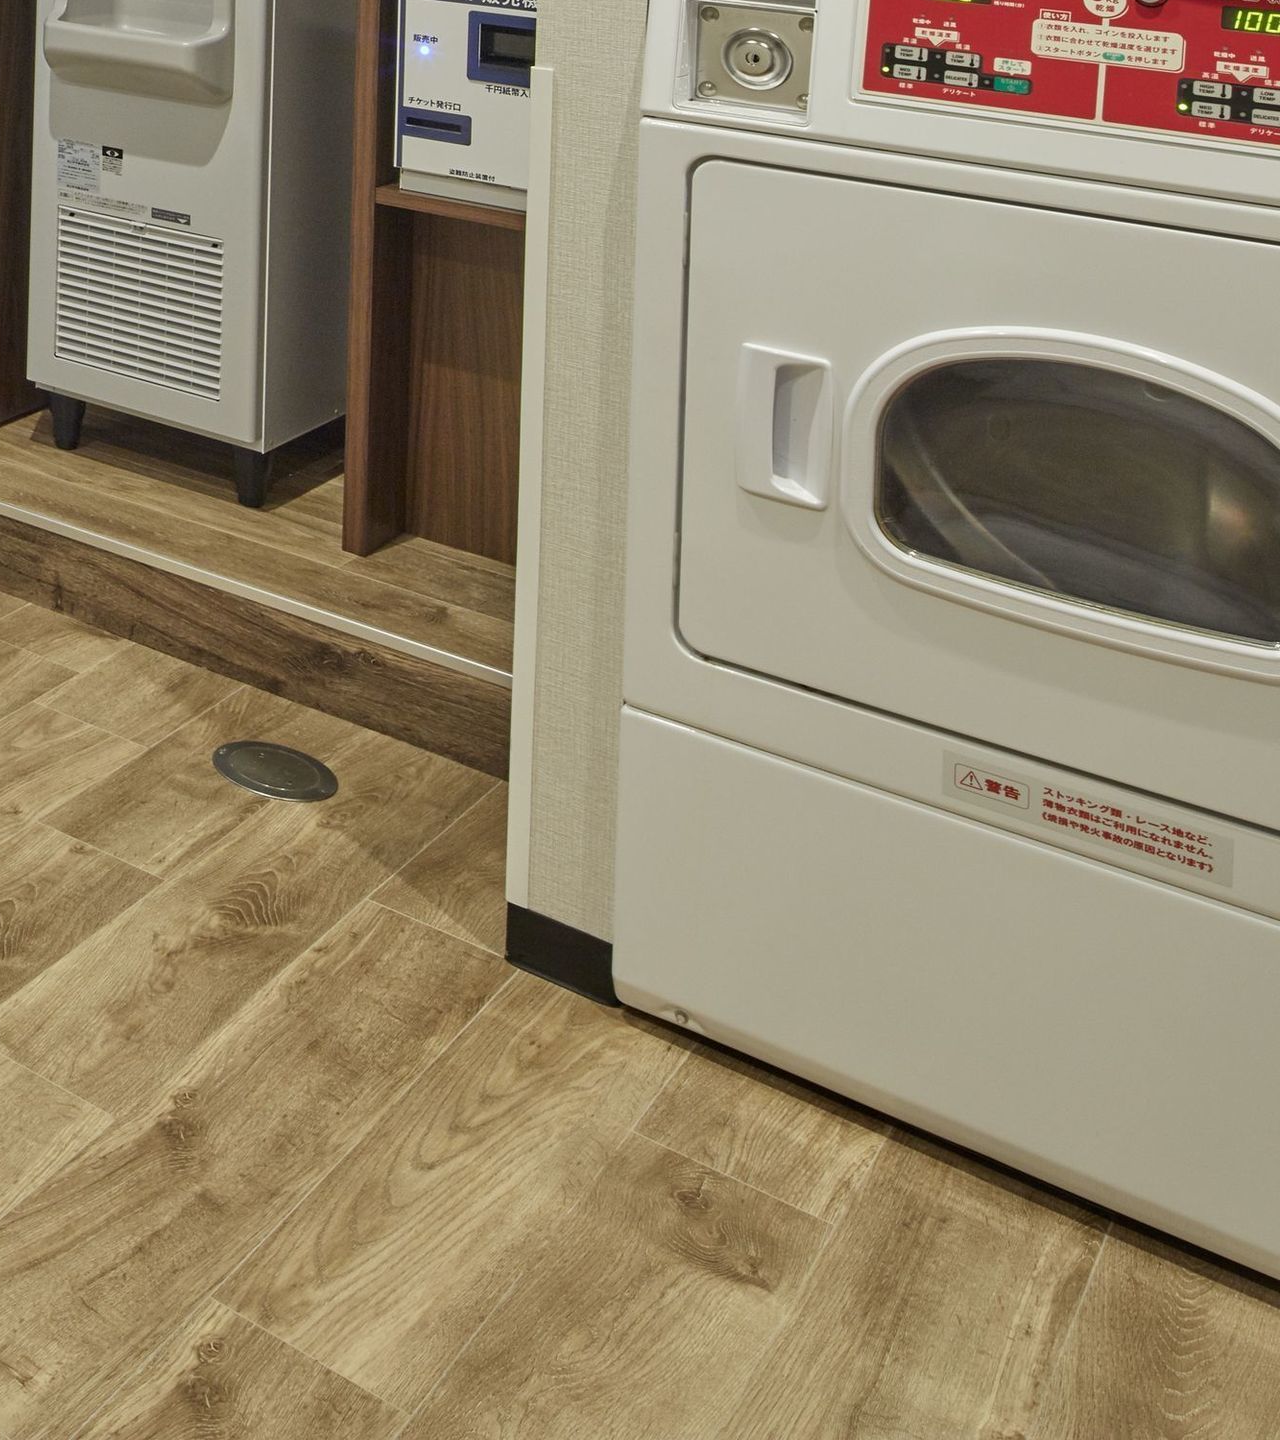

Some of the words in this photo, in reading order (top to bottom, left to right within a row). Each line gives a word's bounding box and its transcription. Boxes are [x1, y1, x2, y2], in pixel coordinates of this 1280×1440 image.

[1095, 4, 1115, 13] 乾燥
[1042, 11, 1069, 21] 使い方
[1234, 10, 1280, 33] 100
[413, 34, 439, 44] 販売中
[1126, 55, 1169, 66] を押します
[1202, 72, 1219, 80] 高温
[485, 84, 531, 98] 千円紙幣入
[942, 87, 976, 97] デリケート
[408, 96, 462, 112] チケット発行口
[984, 778, 1021, 801] 警告
[1043, 786, 1214, 847] ストッキング類・レース地など、
[1042, 798, 1214, 860] 薄物衣類はご利用になれません。
